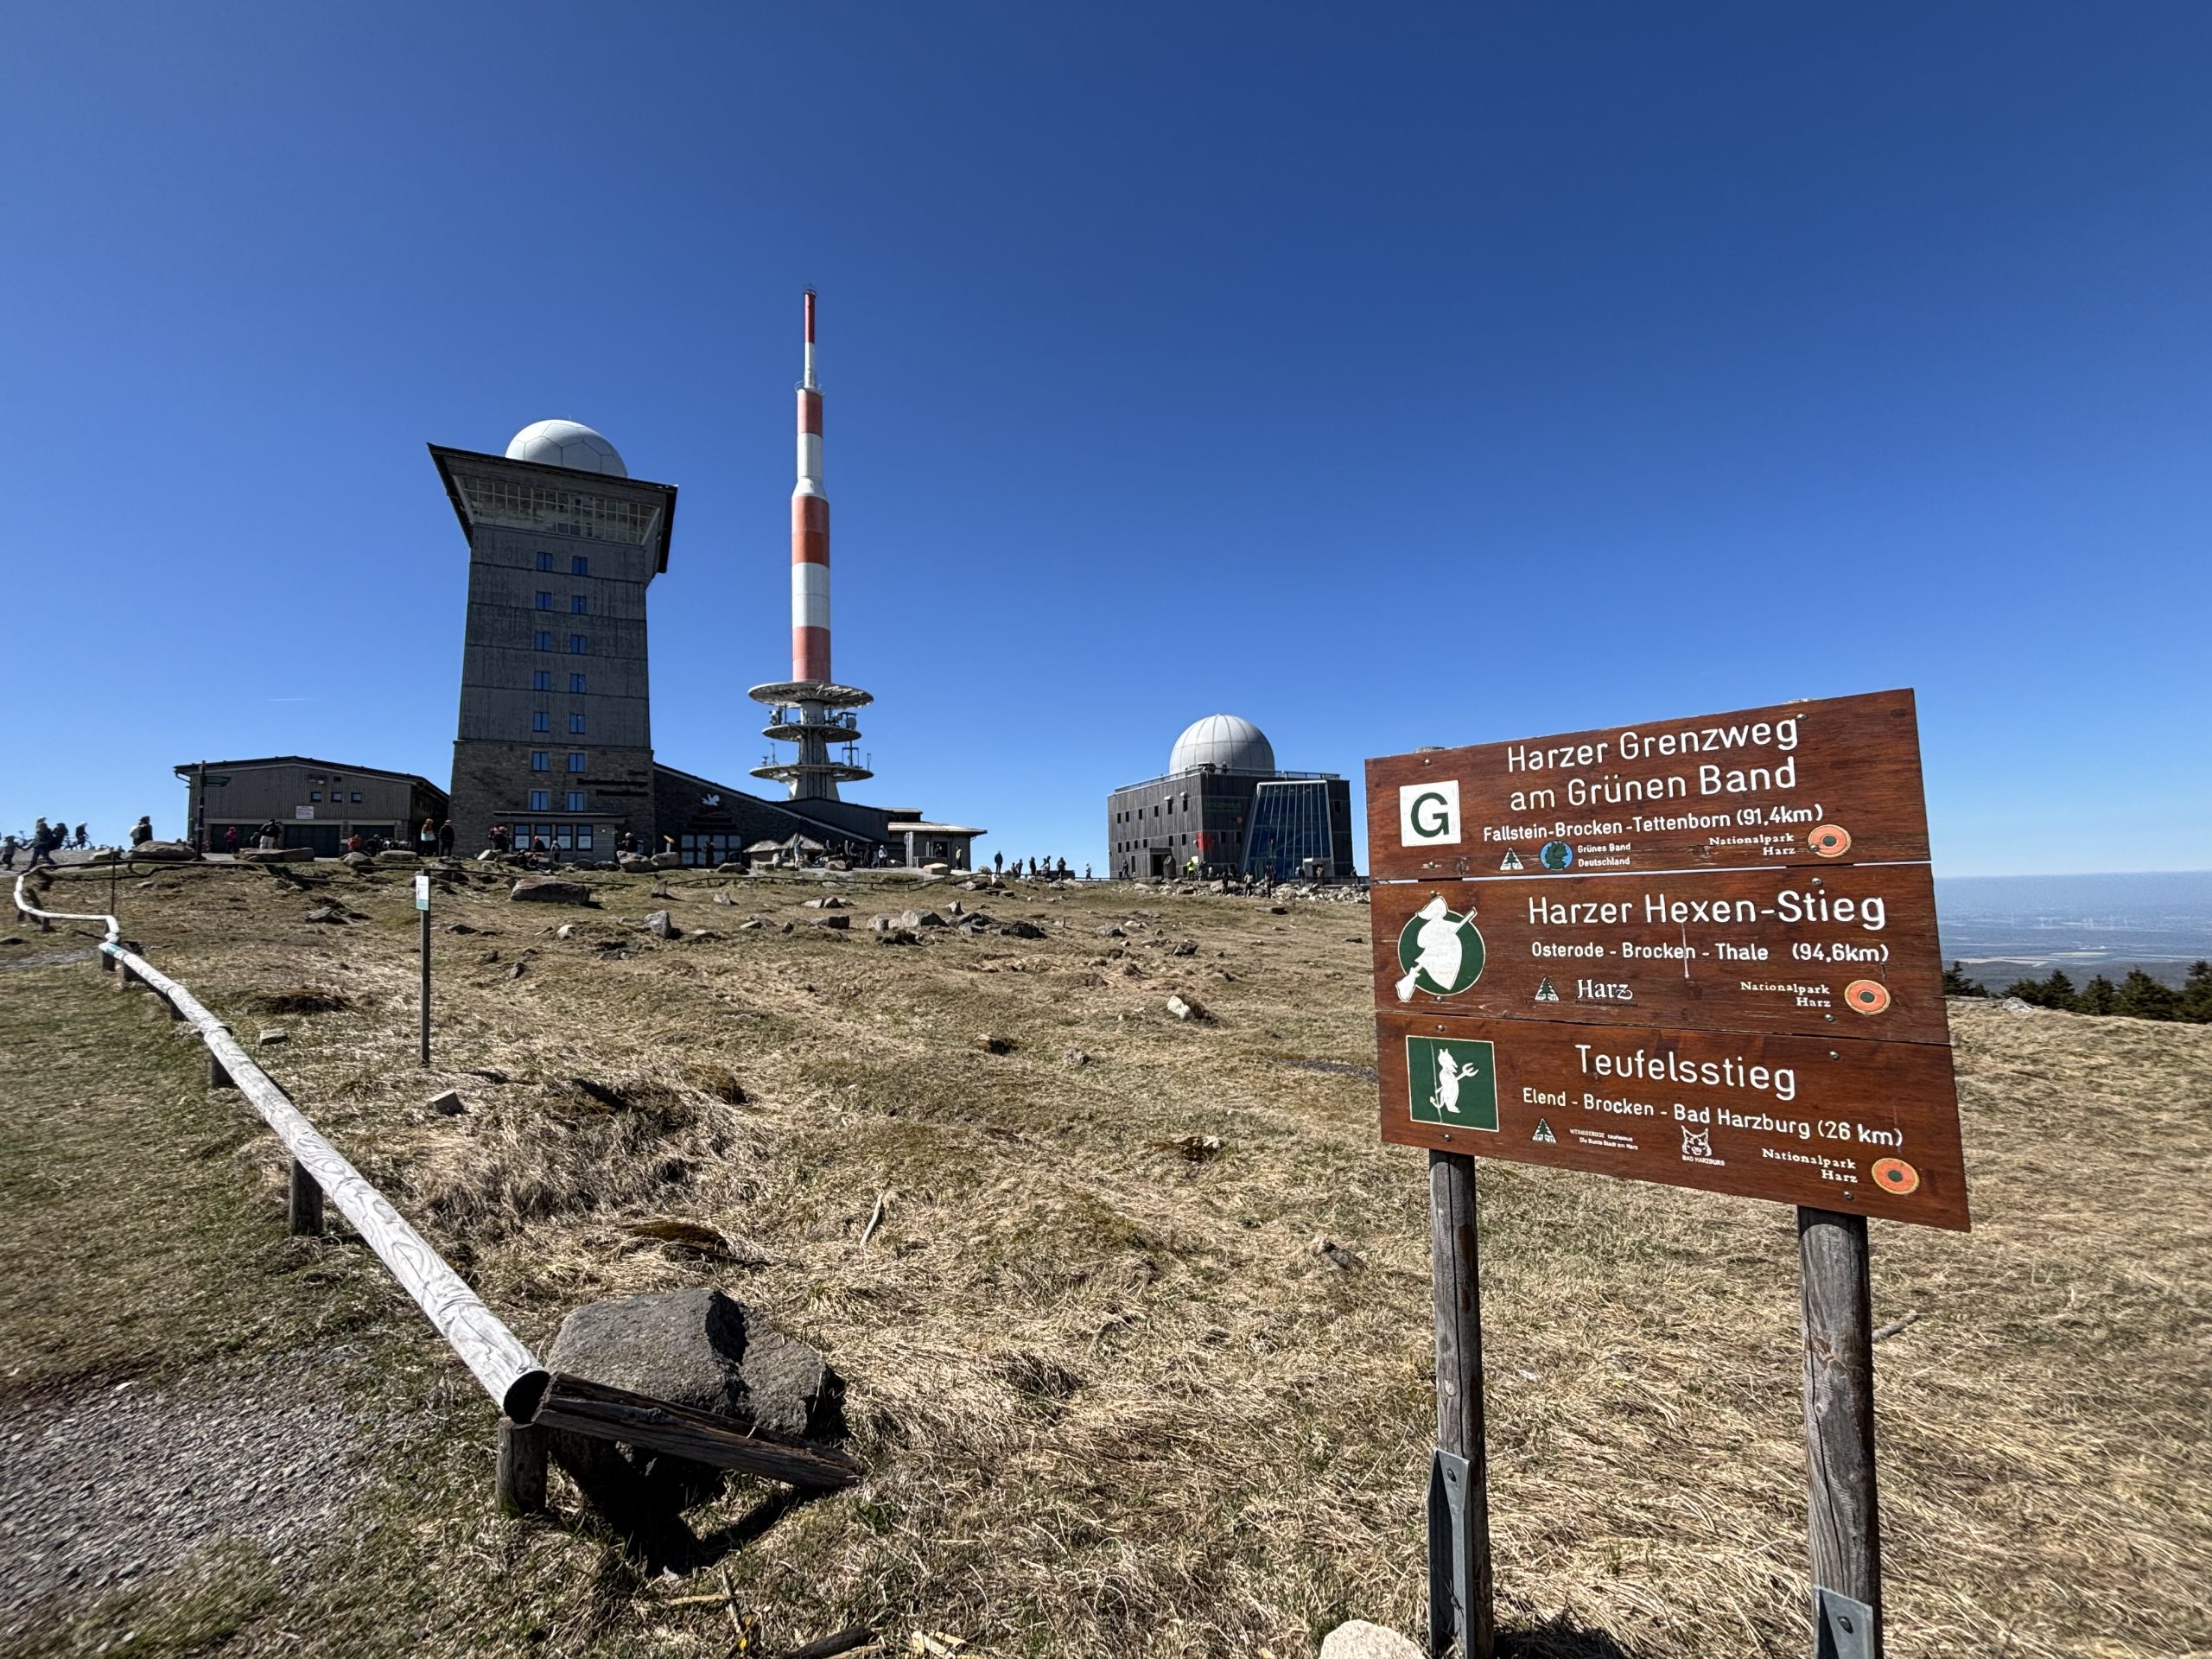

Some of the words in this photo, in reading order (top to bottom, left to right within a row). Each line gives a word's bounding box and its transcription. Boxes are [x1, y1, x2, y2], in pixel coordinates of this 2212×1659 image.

[1507, 741, 1609, 773] Harzer
[1618, 717, 1799, 760] Grenzweg
[1510, 789, 1555, 811] am
[1567, 773, 1687, 806] Grünen
[1699, 755, 1796, 796] Band
[1411, 791, 1449, 838] G
[1736, 803, 1823, 828] (91,4km)
[1577, 844, 1607, 854] Grünes
[1609, 842, 1631, 852] Band
[1708, 832, 1795, 846] Nationalpark
[1578, 856, 1630, 868] Deutschland
[1762, 846, 1796, 856] Harz
[1529, 896, 1633, 925] Harzer
[1644, 889, 1885, 931] Hexen-Stieg
[1531, 941, 1605, 958] Osterode
[1622, 941, 1696, 961] Brocken
[1714, 942, 1769, 962] Thale
[1791, 942, 1889, 963] (94,6km)
[1577, 979, 1633, 1001] Harz
[1740, 981, 1830, 996] Nationalpark
[1796, 995, 1832, 1007] Harz
[1574, 1044, 1796, 1100] Teufelsstieg
[1522, 1087, 1567, 1108] Elend
[1583, 1093, 1655, 1116] Brocken
[1674, 1103, 1711, 1124] Bad
[1717, 1108, 1811, 1140] Harzburg
[1817, 1119, 1851, 1141] (26
[1857, 1123, 1903, 1147] km)
[1694, 1156, 1726, 1166] HARZBURG
[1761, 1147, 1857, 1169] Nationalpark
[1821, 1168, 1858, 1184] Harz
